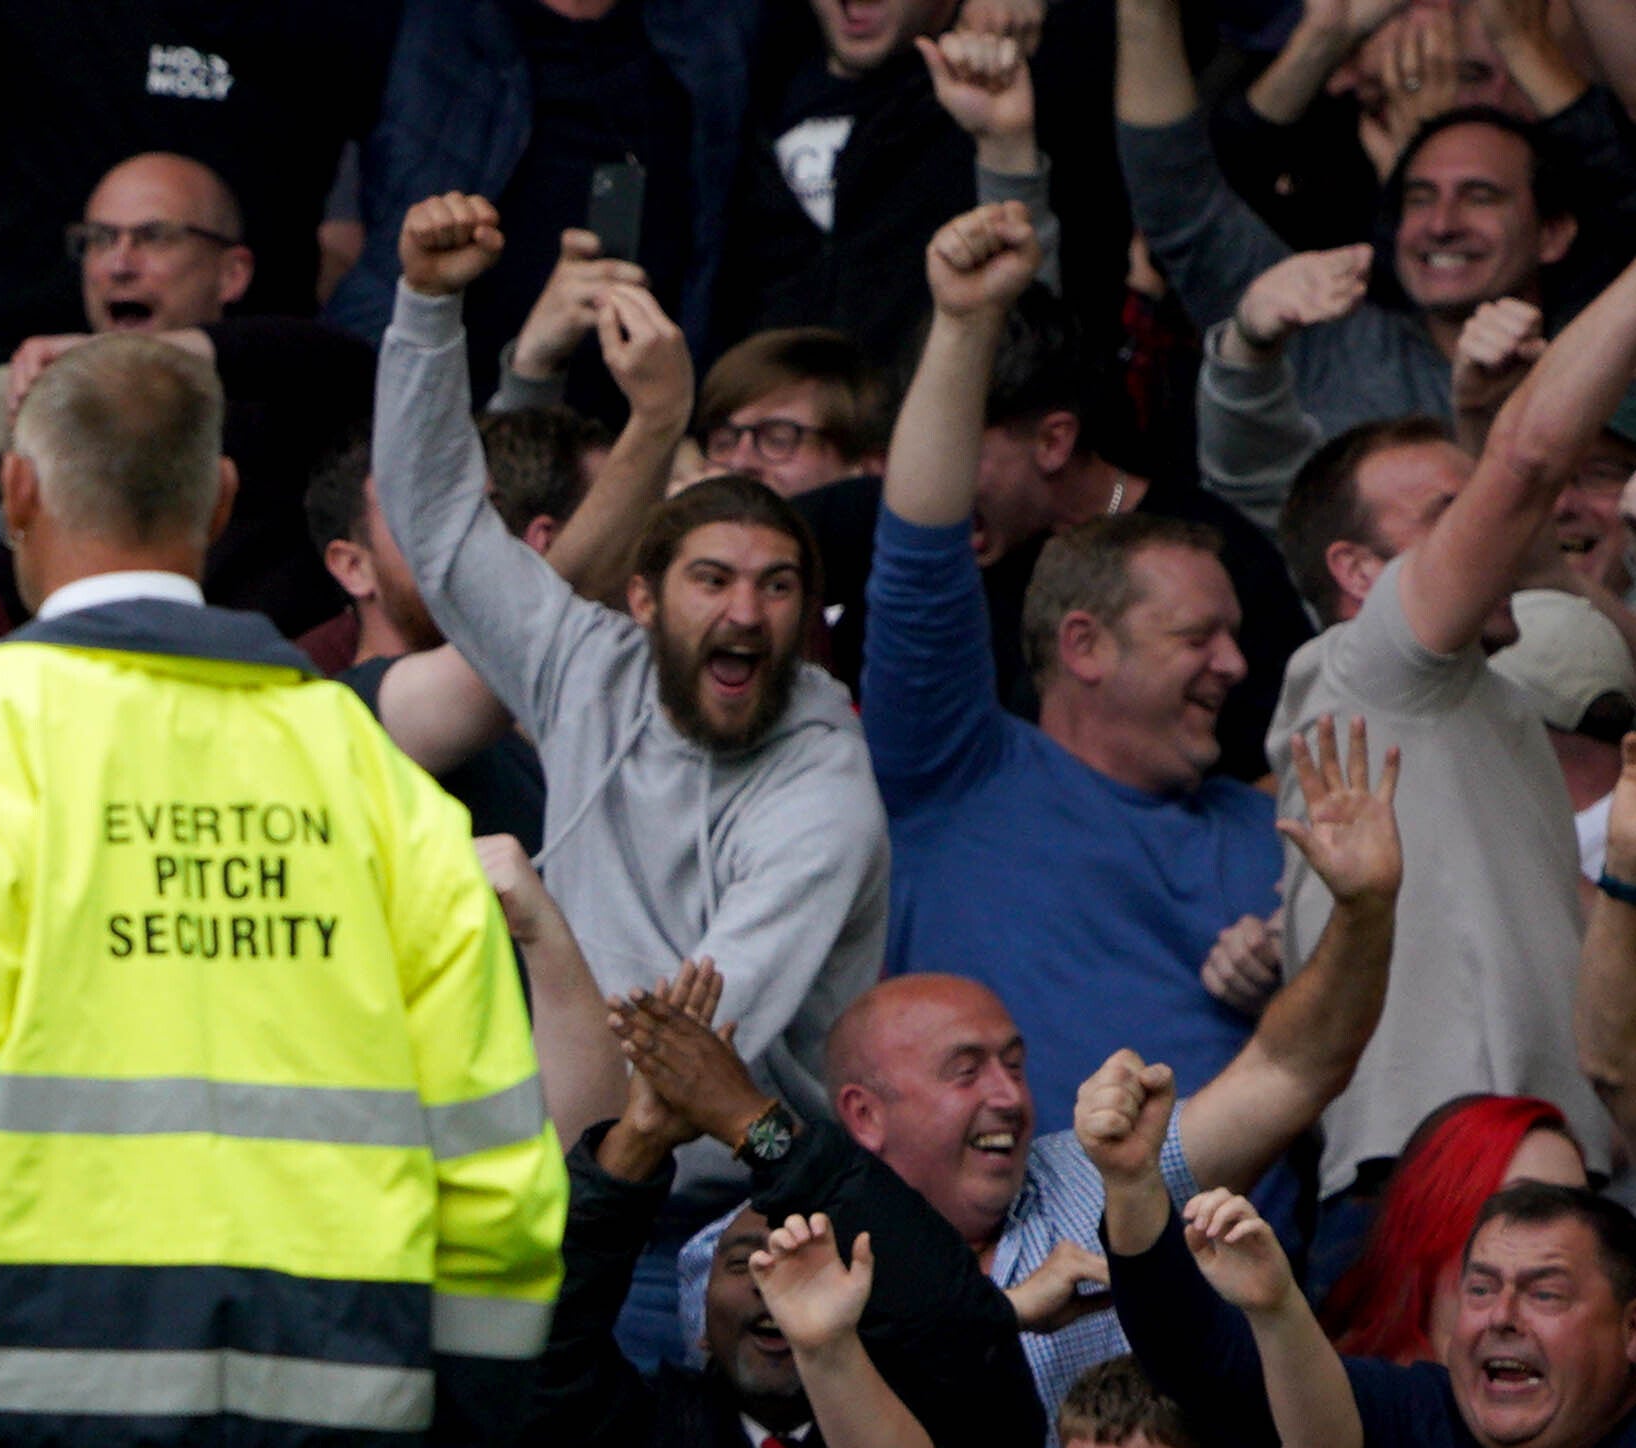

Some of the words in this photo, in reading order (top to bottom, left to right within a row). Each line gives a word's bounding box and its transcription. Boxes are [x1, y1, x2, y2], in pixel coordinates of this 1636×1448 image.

[104, 803, 331, 845] EVERTON
[154, 855, 288, 900] PITCH
[108, 912, 338, 959] SECURITY
